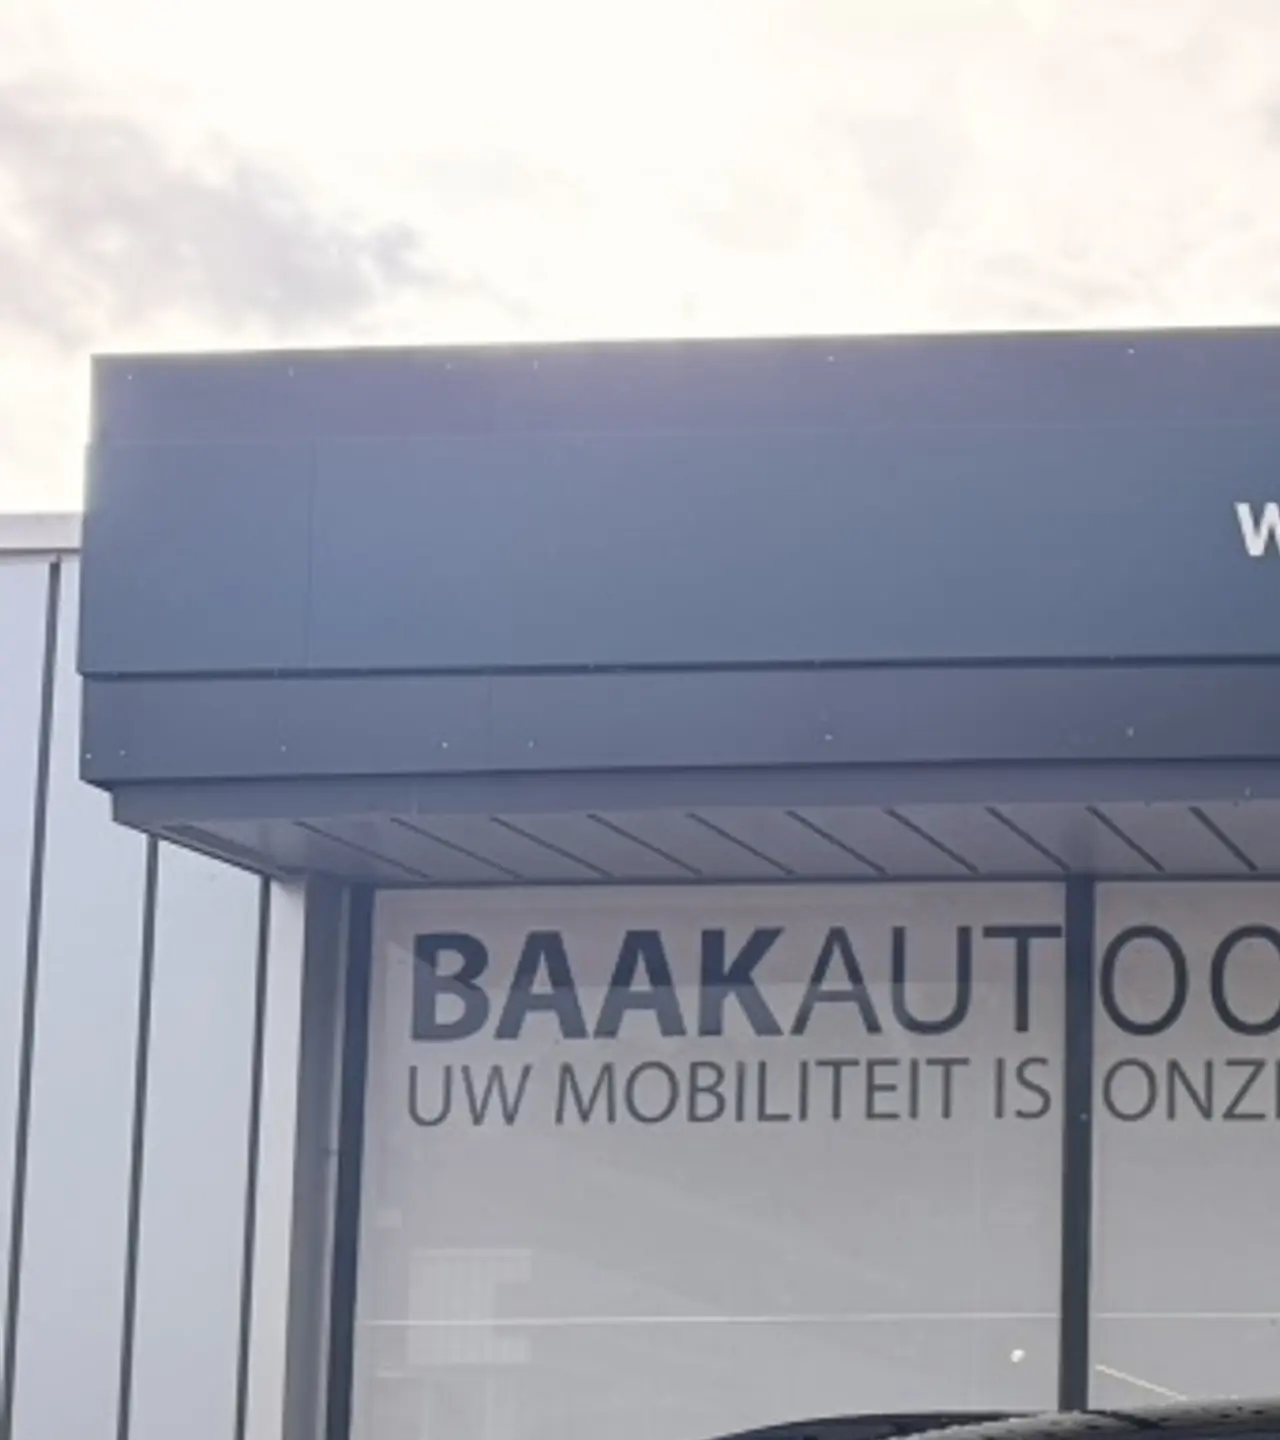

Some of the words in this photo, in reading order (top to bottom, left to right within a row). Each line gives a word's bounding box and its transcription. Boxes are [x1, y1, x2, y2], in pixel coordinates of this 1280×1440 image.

[407, 1064, 533, 1127] UW
[554, 1056, 970, 1125] MOBILITEIT
[993, 1056, 1052, 1119] IS
